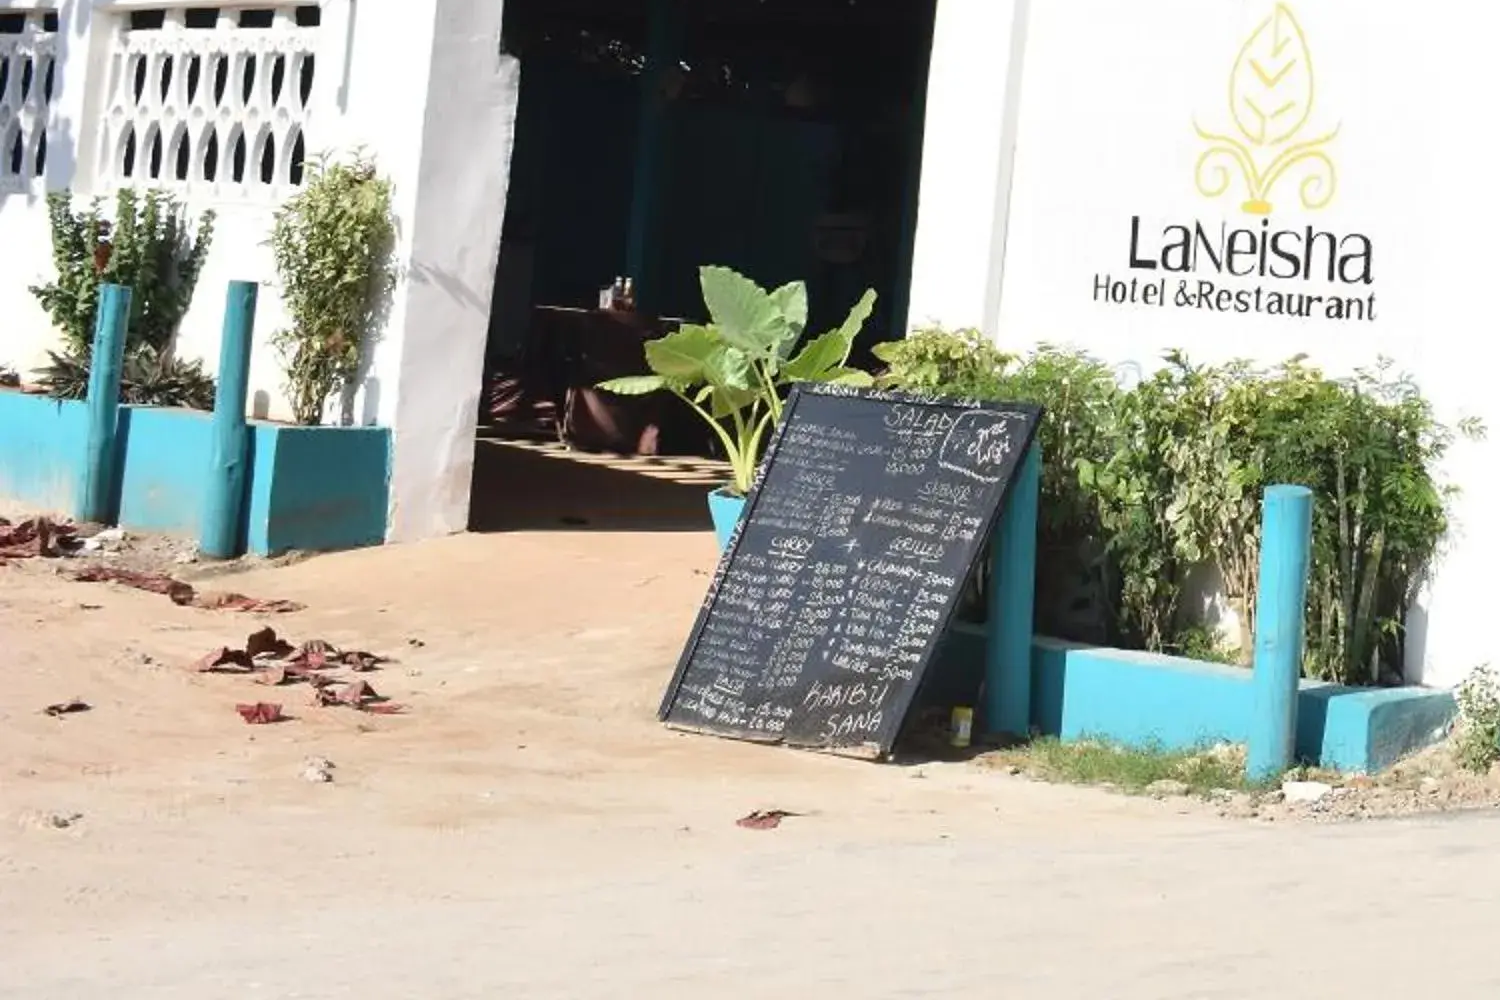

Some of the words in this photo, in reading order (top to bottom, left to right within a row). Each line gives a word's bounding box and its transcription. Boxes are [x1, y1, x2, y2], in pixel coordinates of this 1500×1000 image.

[1129, 216, 1374, 285] LaNeisha
[1093, 273, 1166, 307] Hotel
[884, 403, 954, 430] SALAD
[802, 680, 890, 712] KARIBU
[826, 711, 884, 737] SANA
